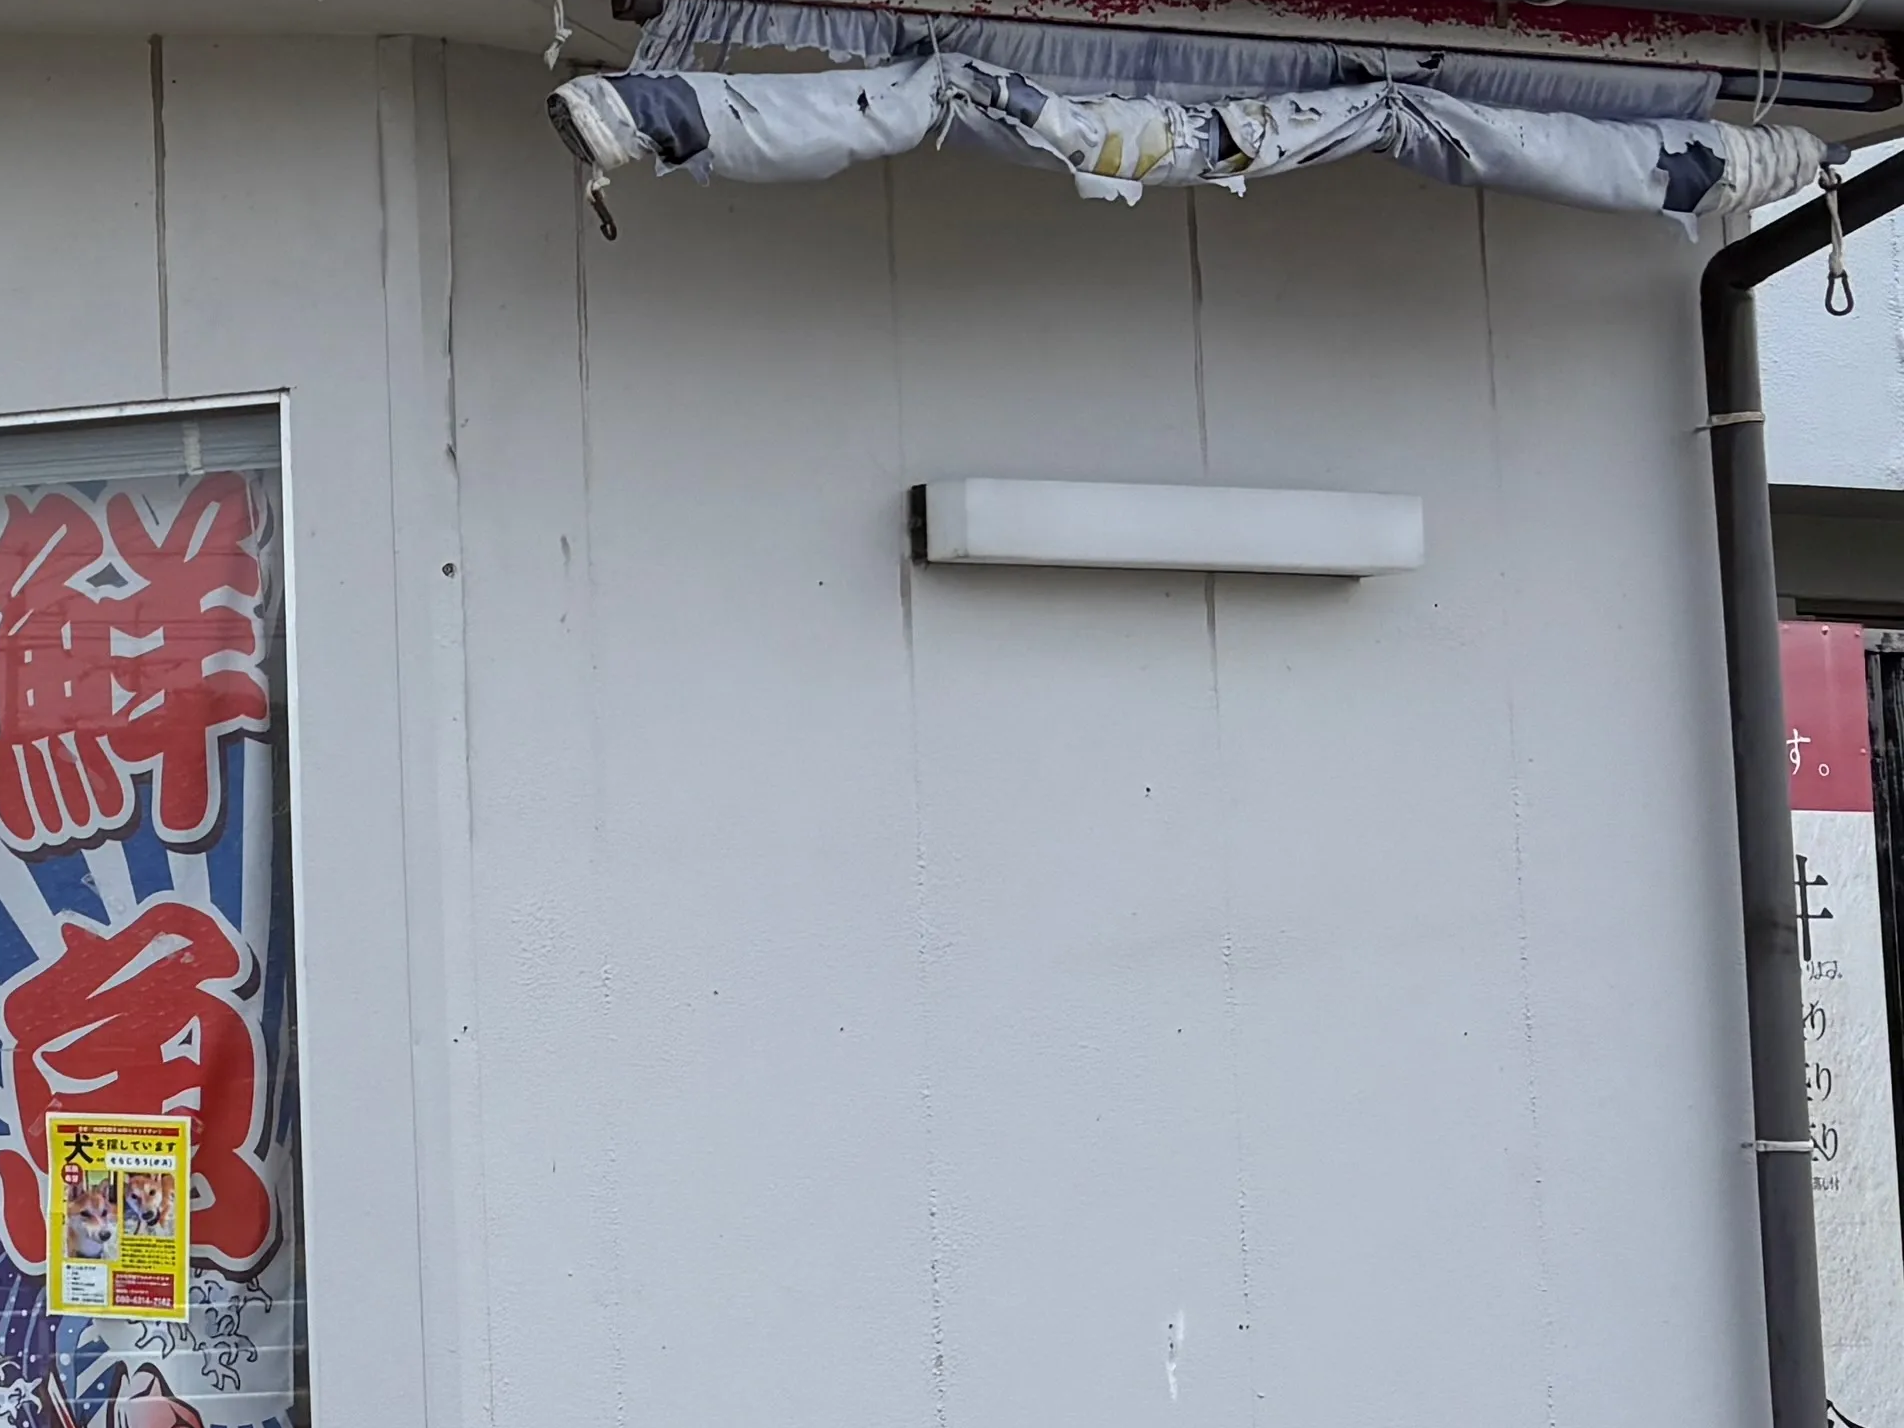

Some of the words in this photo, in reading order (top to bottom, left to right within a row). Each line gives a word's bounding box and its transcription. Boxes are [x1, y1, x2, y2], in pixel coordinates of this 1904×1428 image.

[64, 1133, 177, 1164] 犬を探しています
